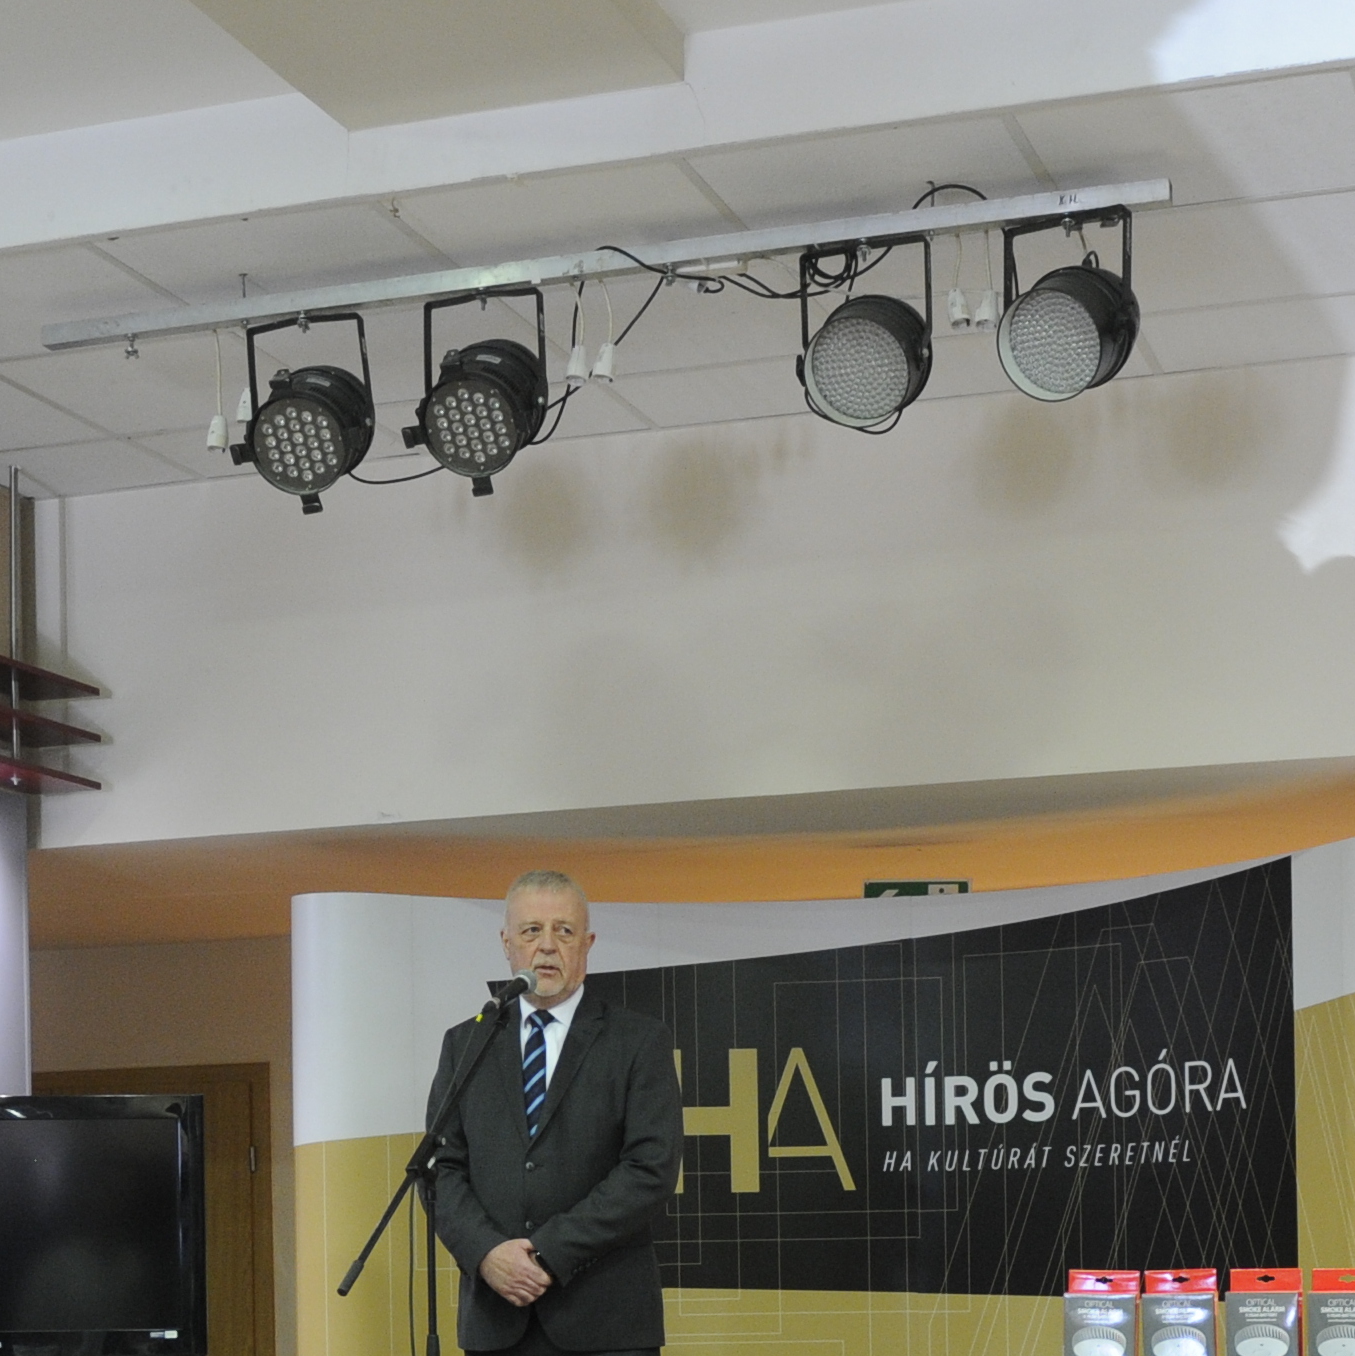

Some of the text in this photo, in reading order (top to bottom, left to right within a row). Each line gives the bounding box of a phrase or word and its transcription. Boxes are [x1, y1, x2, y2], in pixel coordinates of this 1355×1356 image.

[881, 1048, 1247, 1126] HÍRÖS AGÓRA
[883, 1135, 1192, 1172] HA KULTÚRÁT SZERETNÉL
[1245, 1298, 1277, 1306] OPTICAL
